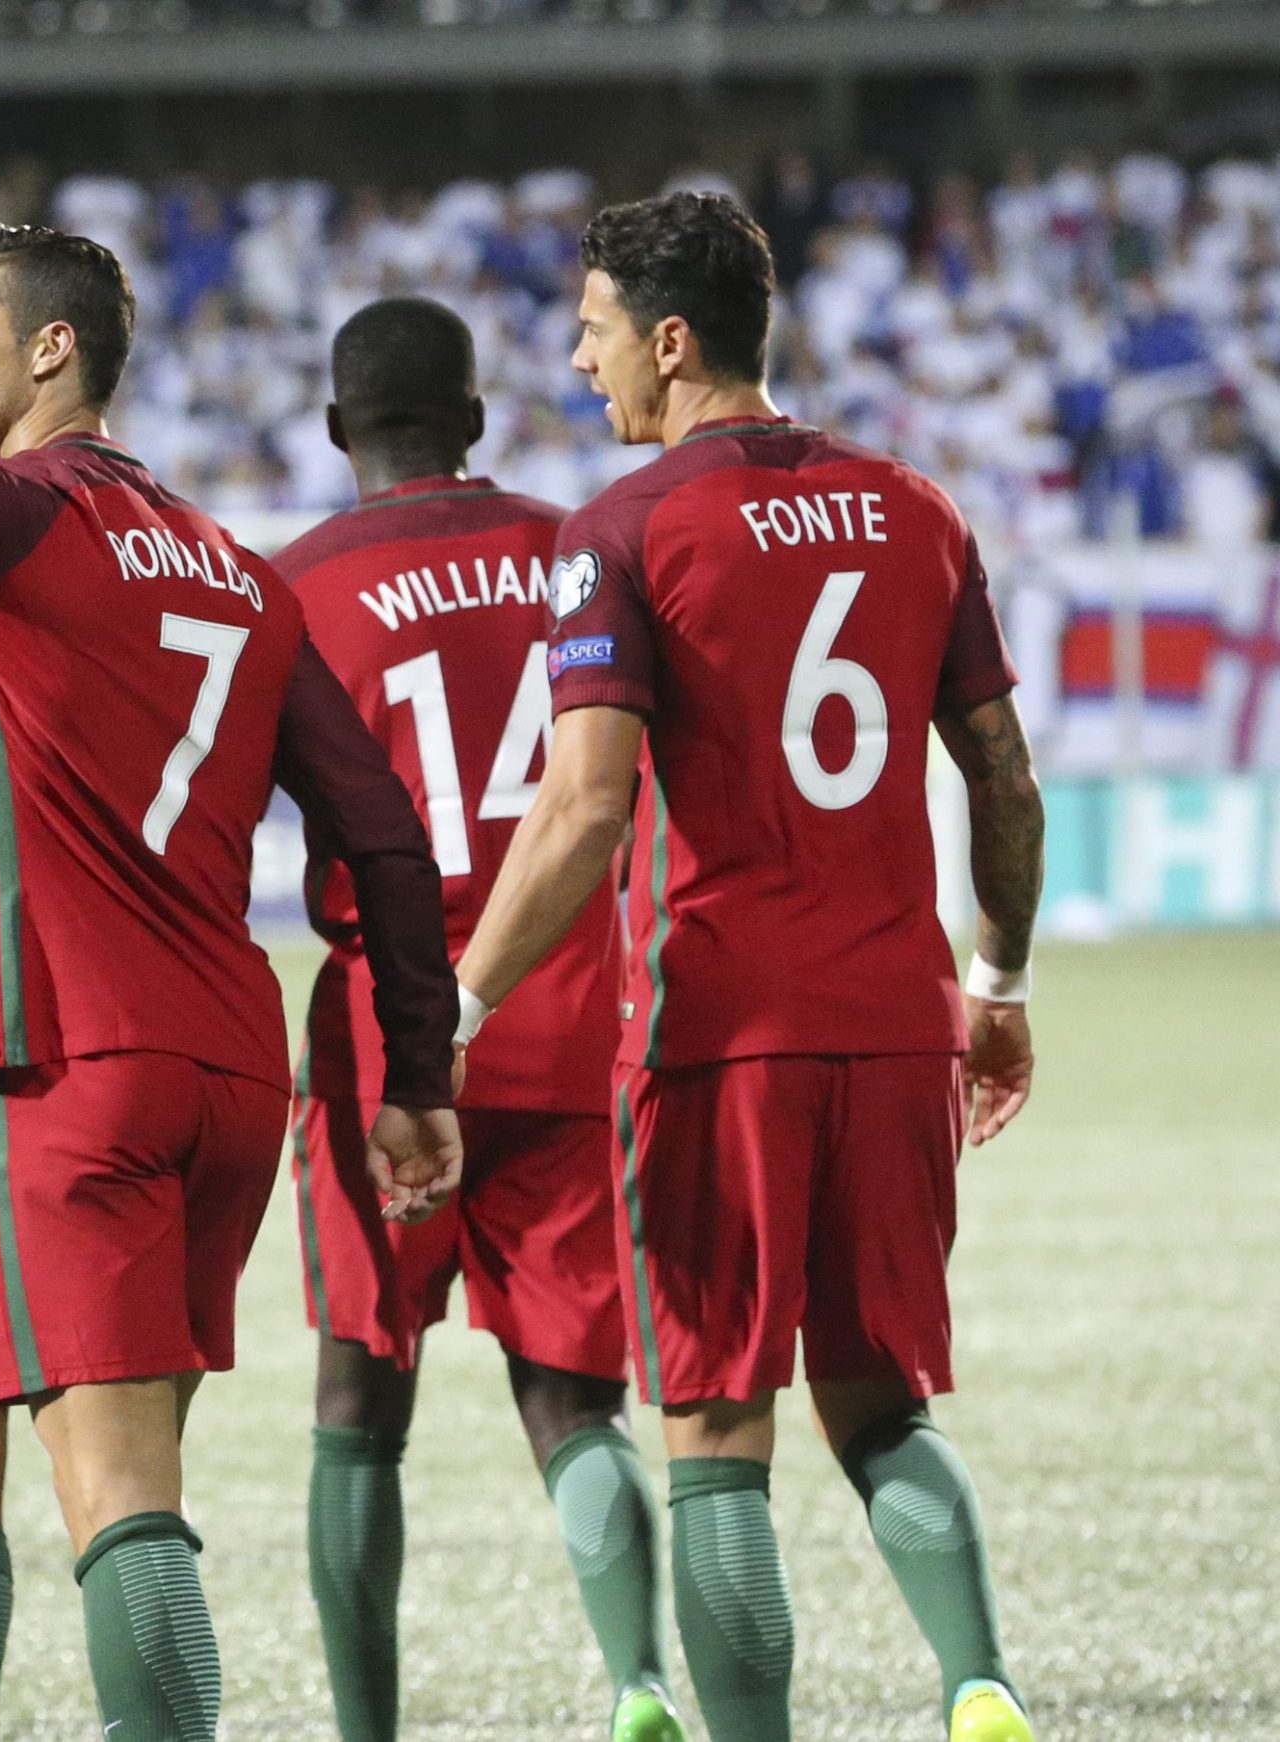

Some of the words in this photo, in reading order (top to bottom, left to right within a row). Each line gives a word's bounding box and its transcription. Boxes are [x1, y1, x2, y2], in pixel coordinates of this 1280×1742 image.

[106, 527, 263, 612] RONALDO
[740, 492, 887, 552] FONTE
[142, 612, 250, 855] 7
[383, 641, 553, 877] 14
[782, 571, 888, 810] 6
